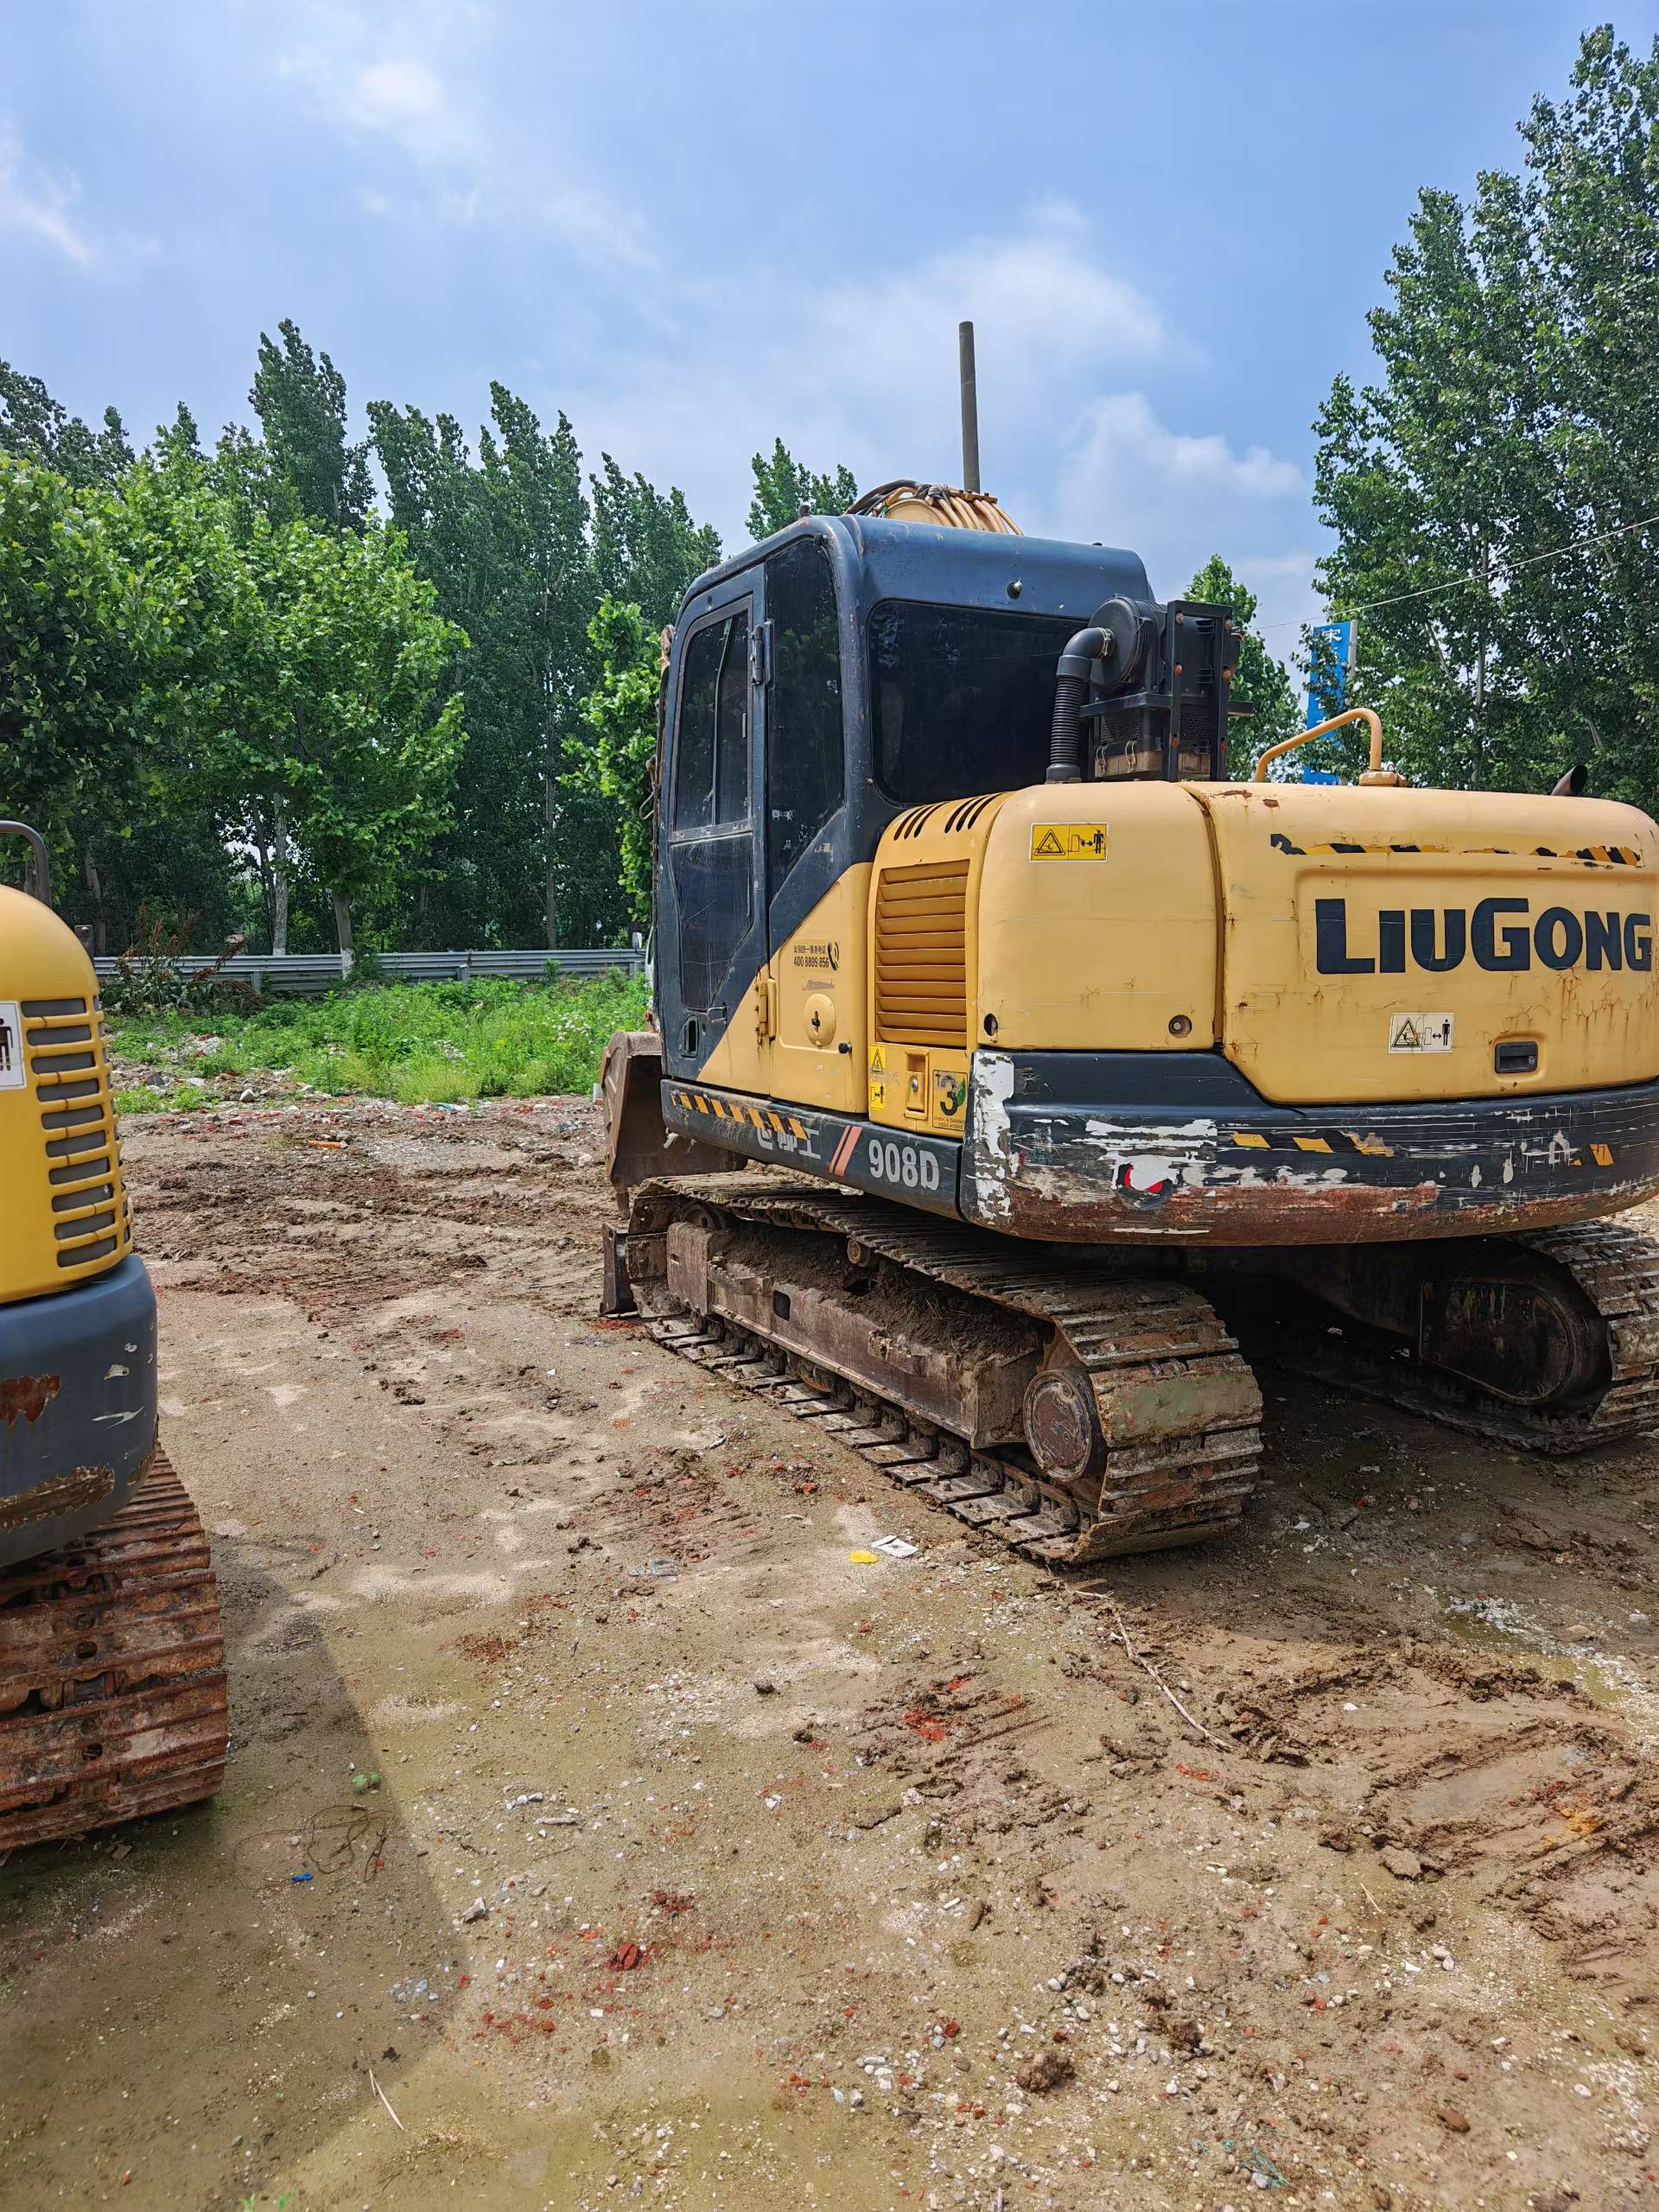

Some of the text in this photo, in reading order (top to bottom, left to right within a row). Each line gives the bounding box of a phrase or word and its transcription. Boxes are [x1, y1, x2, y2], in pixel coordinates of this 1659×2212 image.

[793, 957, 830, 969] 400 8899 856
[868, 1139, 940, 1191] 908D
